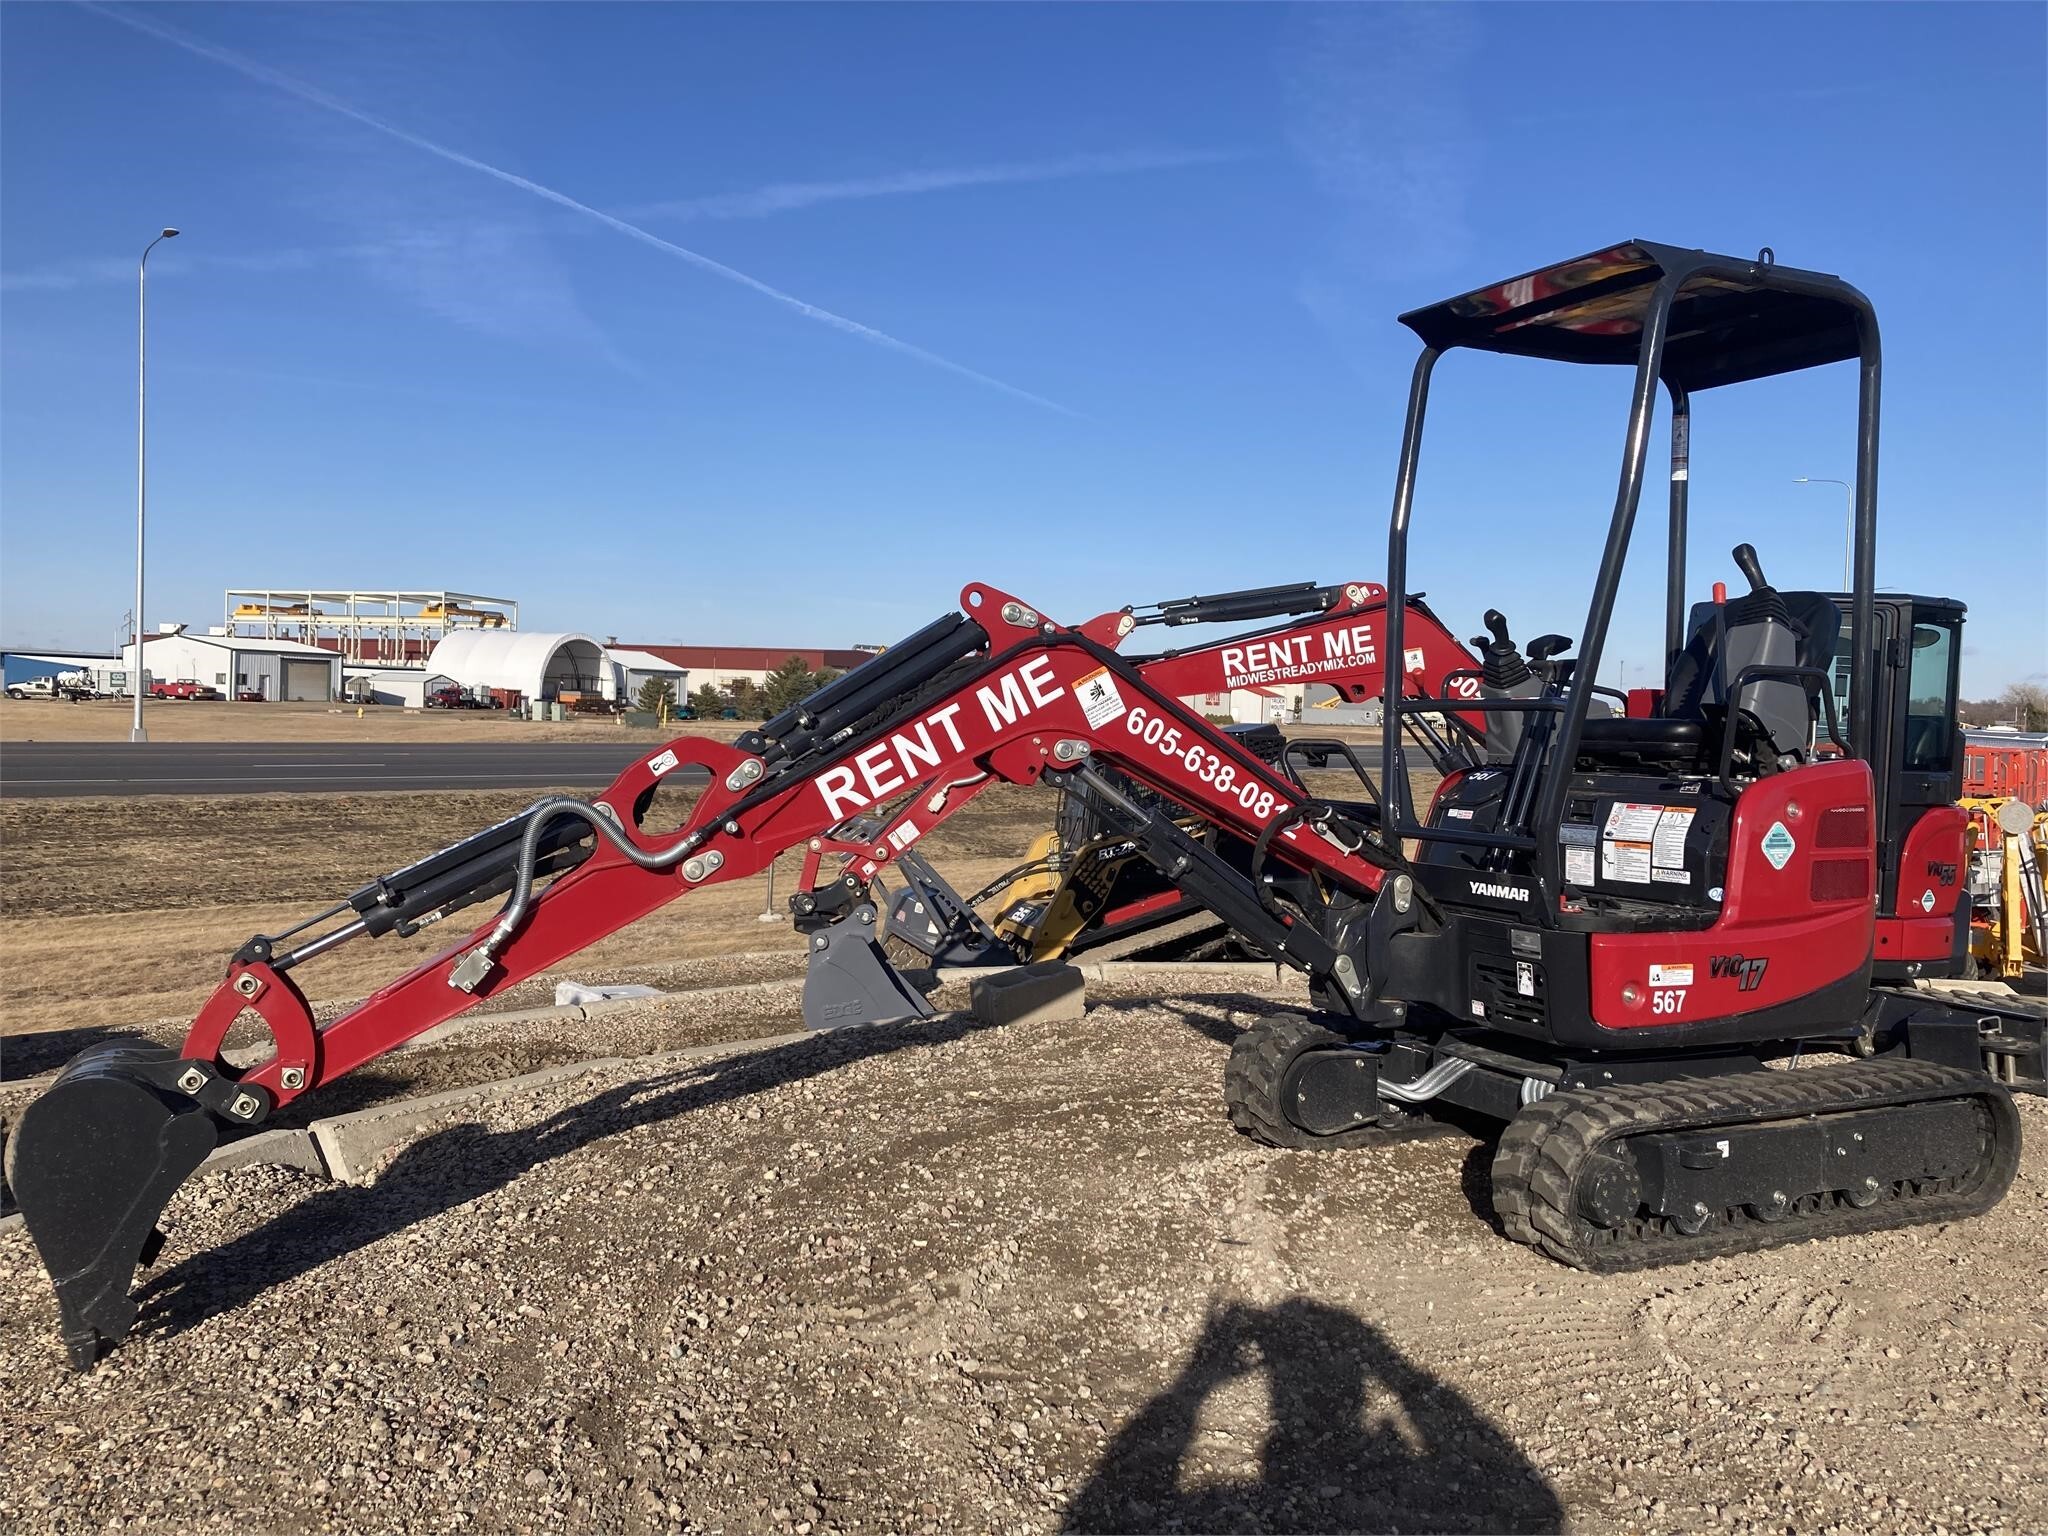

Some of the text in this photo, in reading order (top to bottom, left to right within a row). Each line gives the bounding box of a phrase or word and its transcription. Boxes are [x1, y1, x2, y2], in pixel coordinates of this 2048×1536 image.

[1221, 624, 1375, 677] RENT ME
[1226, 651, 1376, 689] MIDWESTREADYMIX.COM
[814, 654, 1065, 821] RENT ME
[1661, 870, 1687, 878] WARNING
[1469, 881, 1530, 902] YANMAR
[1652, 989, 1687, 1014] 567
